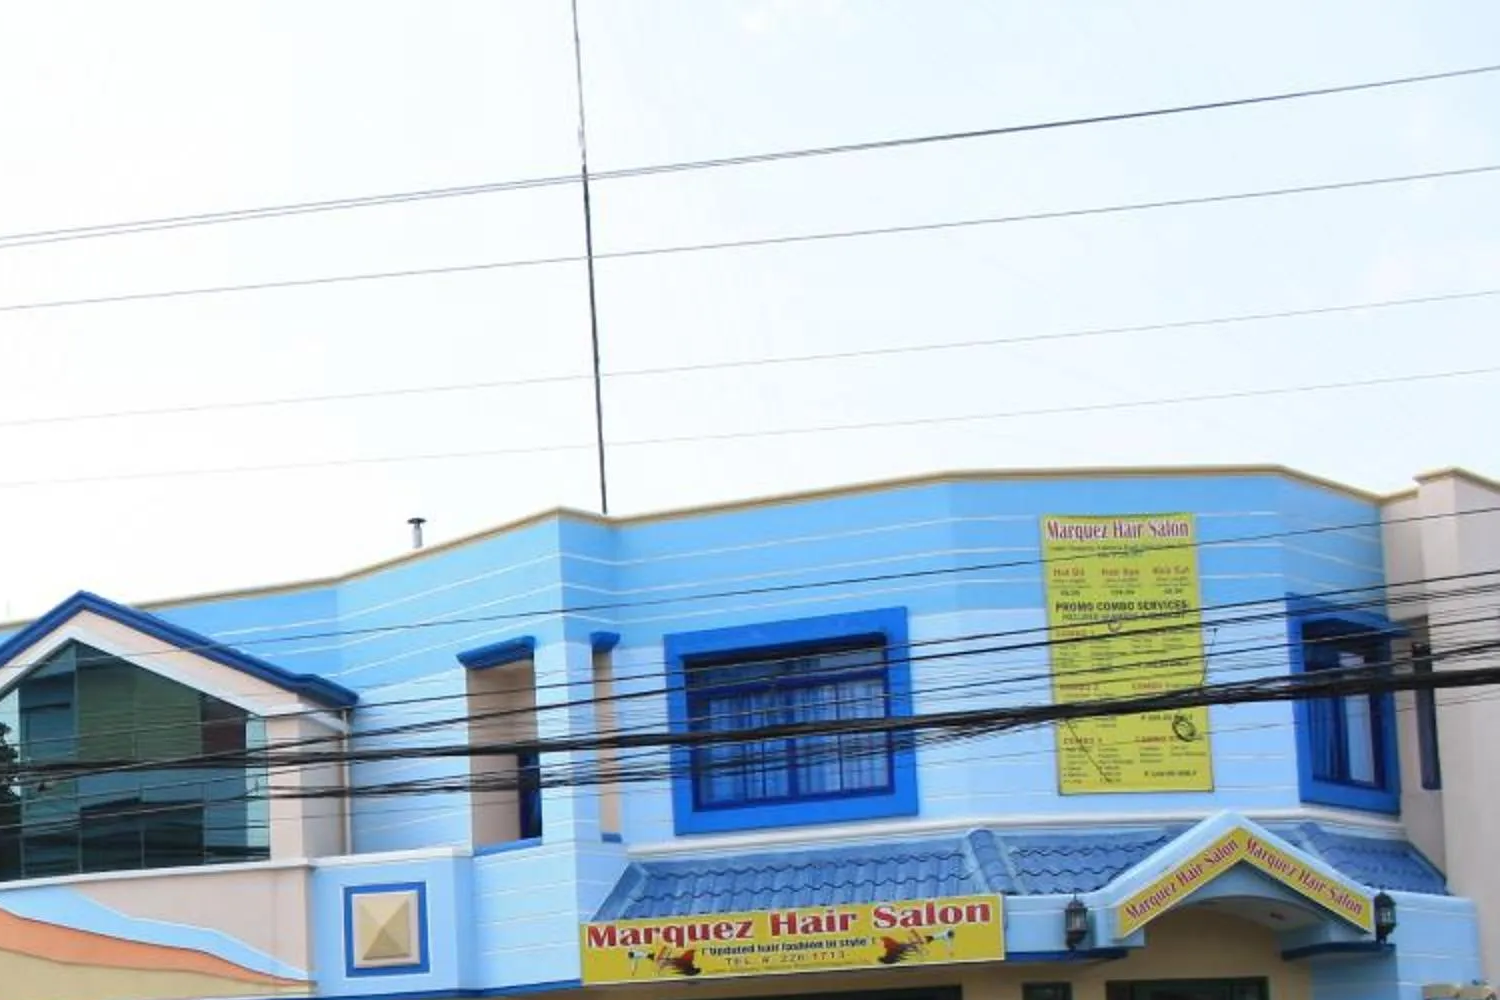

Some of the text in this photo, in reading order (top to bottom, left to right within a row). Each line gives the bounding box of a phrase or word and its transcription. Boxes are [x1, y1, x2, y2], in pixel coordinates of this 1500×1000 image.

[1047, 518, 1189, 541] Marquez Hair Salon
[1055, 599, 1189, 612] PROMO COMBO SERVICES
[1125, 838, 1239, 920] Marquez Hair Salon
[1245, 837, 1363, 917] Marquez Hair Salon
[586, 901, 992, 949] Marquez Hair Salon
